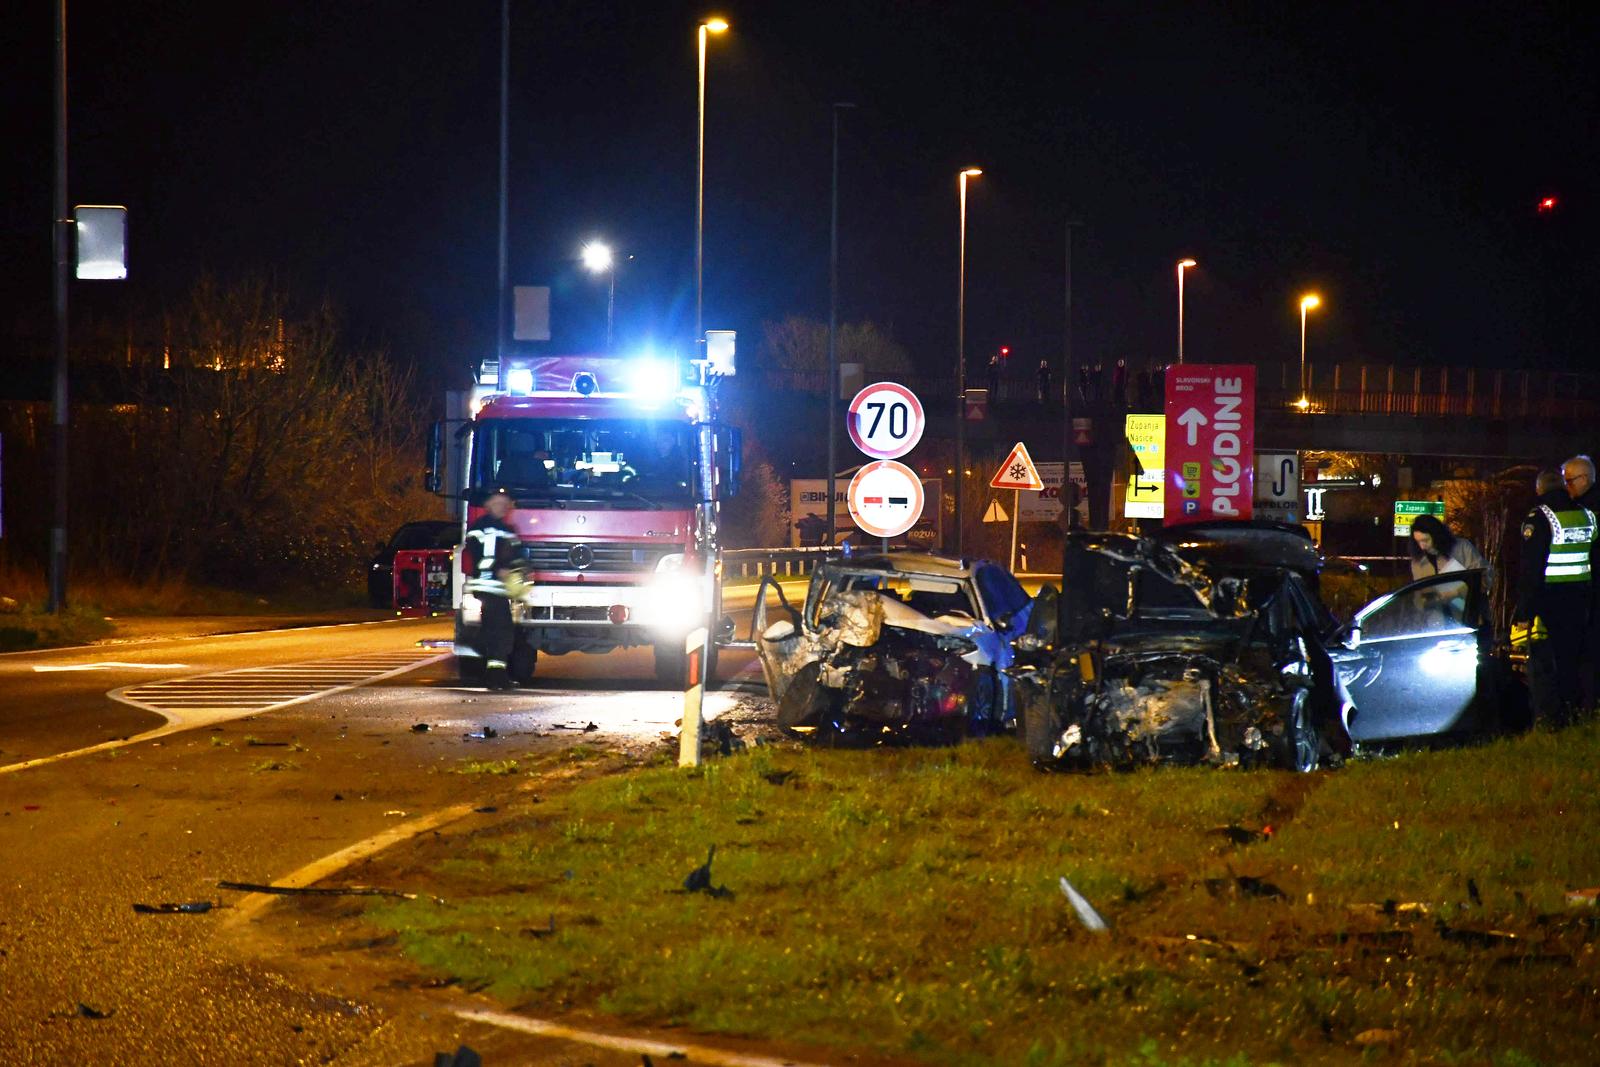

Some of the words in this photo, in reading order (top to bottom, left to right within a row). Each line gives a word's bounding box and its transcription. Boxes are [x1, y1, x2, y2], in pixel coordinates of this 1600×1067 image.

[867, 402, 908, 439] 70
[1212, 377, 1242, 517] PLODINE
[1186, 502, 1196, 514] P
